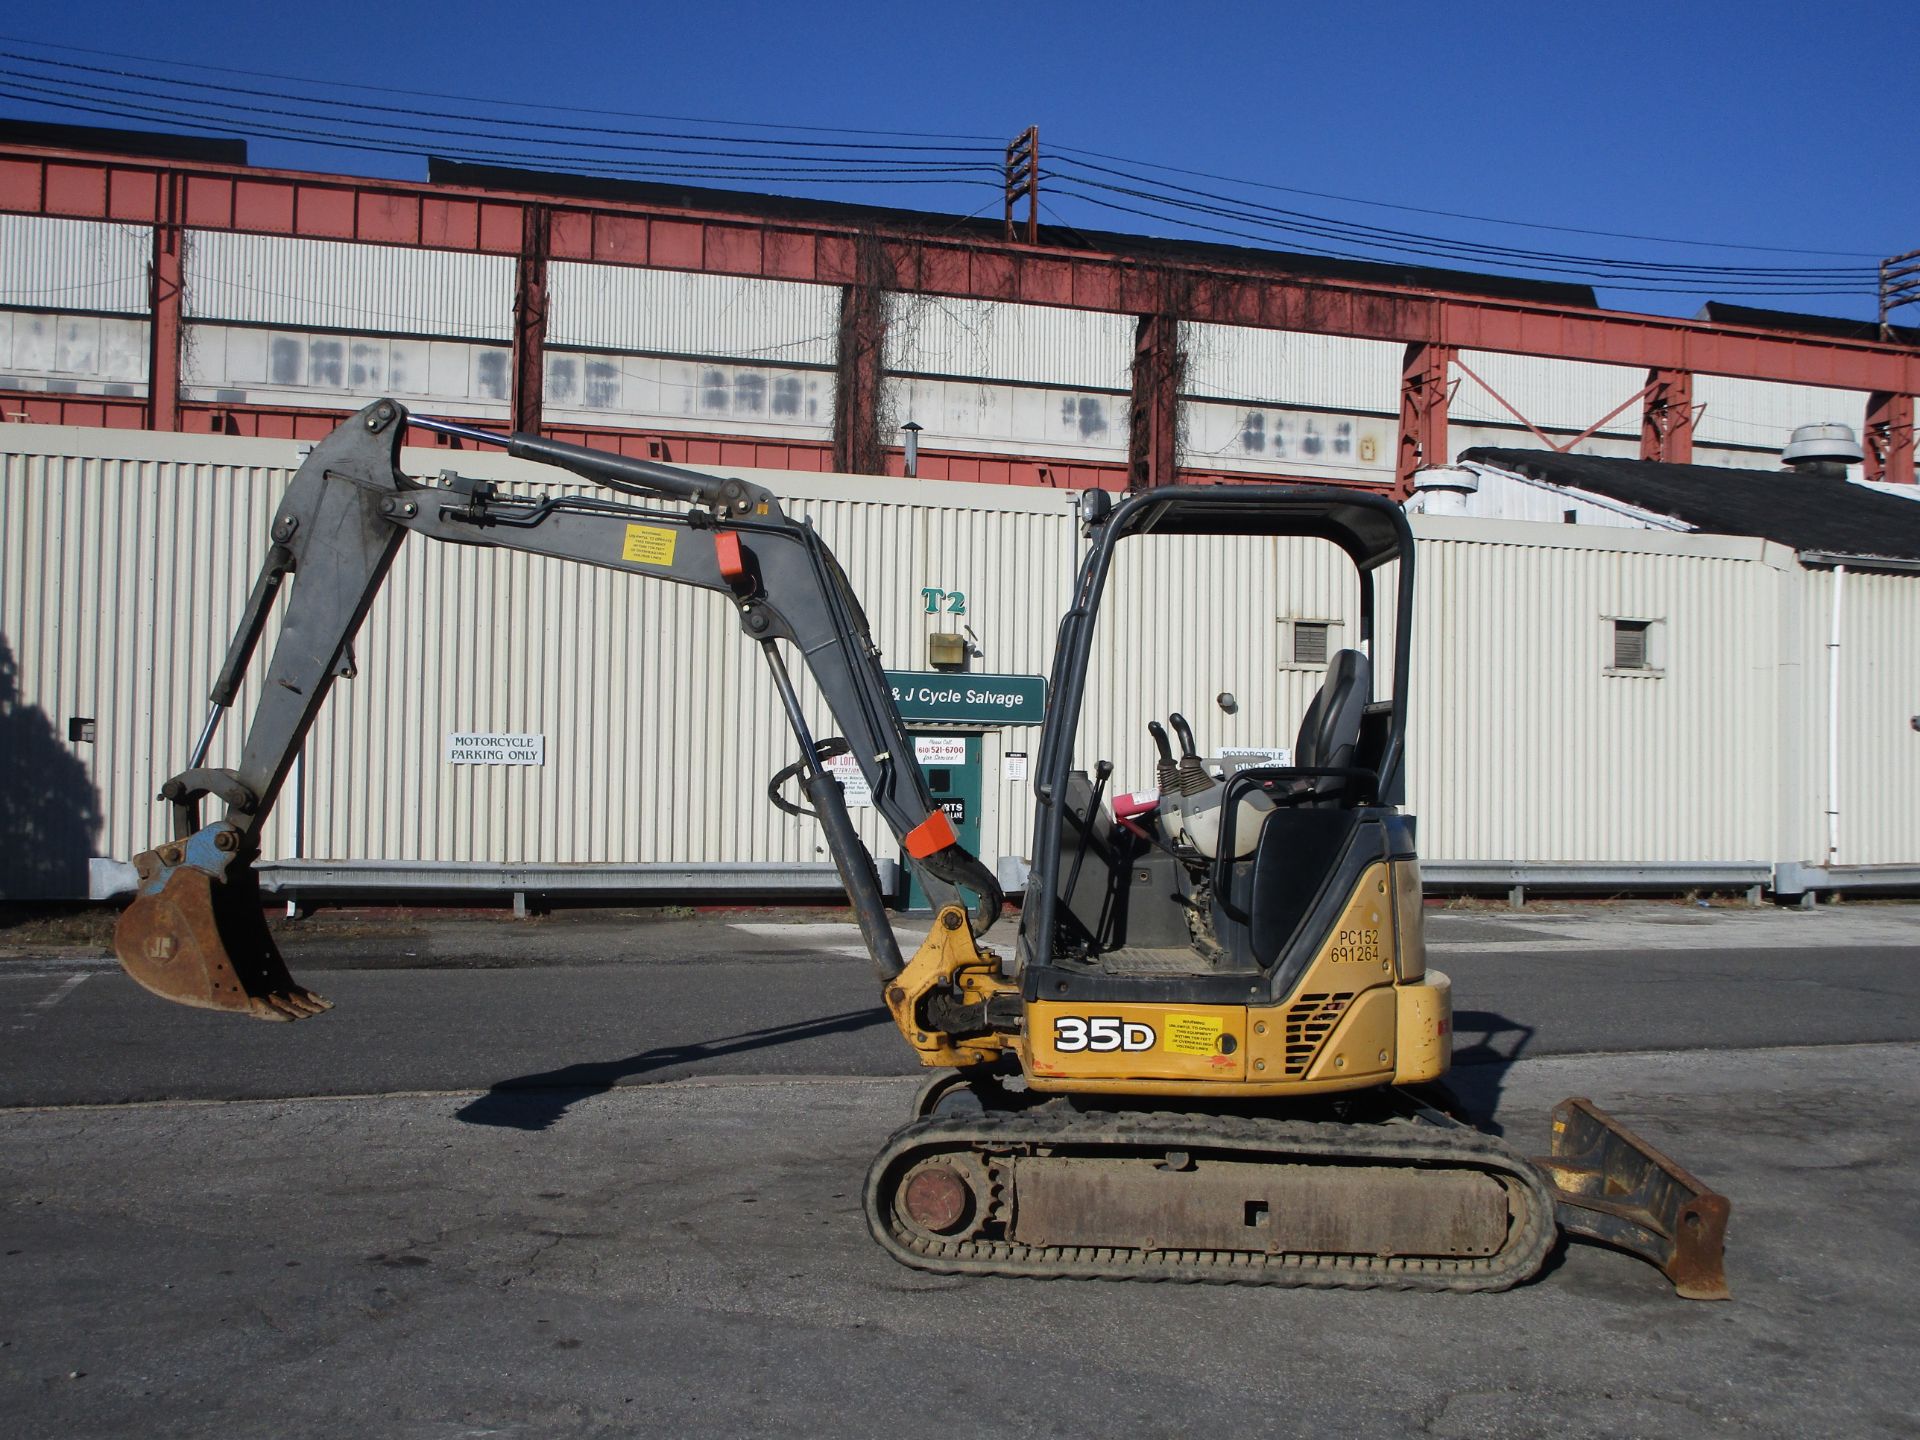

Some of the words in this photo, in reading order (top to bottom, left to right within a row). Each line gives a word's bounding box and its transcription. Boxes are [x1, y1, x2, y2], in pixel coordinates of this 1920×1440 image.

[921, 587, 966, 615] T2
[891, 687, 901, 701] &
[905, 687, 915, 702] J
[918, 688, 962, 706] Cycle
[966, 689, 1024, 708] Salvage
[455, 737, 534, 747] MOTORCYCLE
[931, 745, 964, 754] 521-6700
[451, 749, 504, 760] PARKING
[508, 750, 538, 761] ONLY
[943, 803, 963, 812] RTS
[1340, 930, 1378, 945] PC152
[1331, 946, 1378, 962] 691264
[1054, 1016, 1157, 1053] 35D
